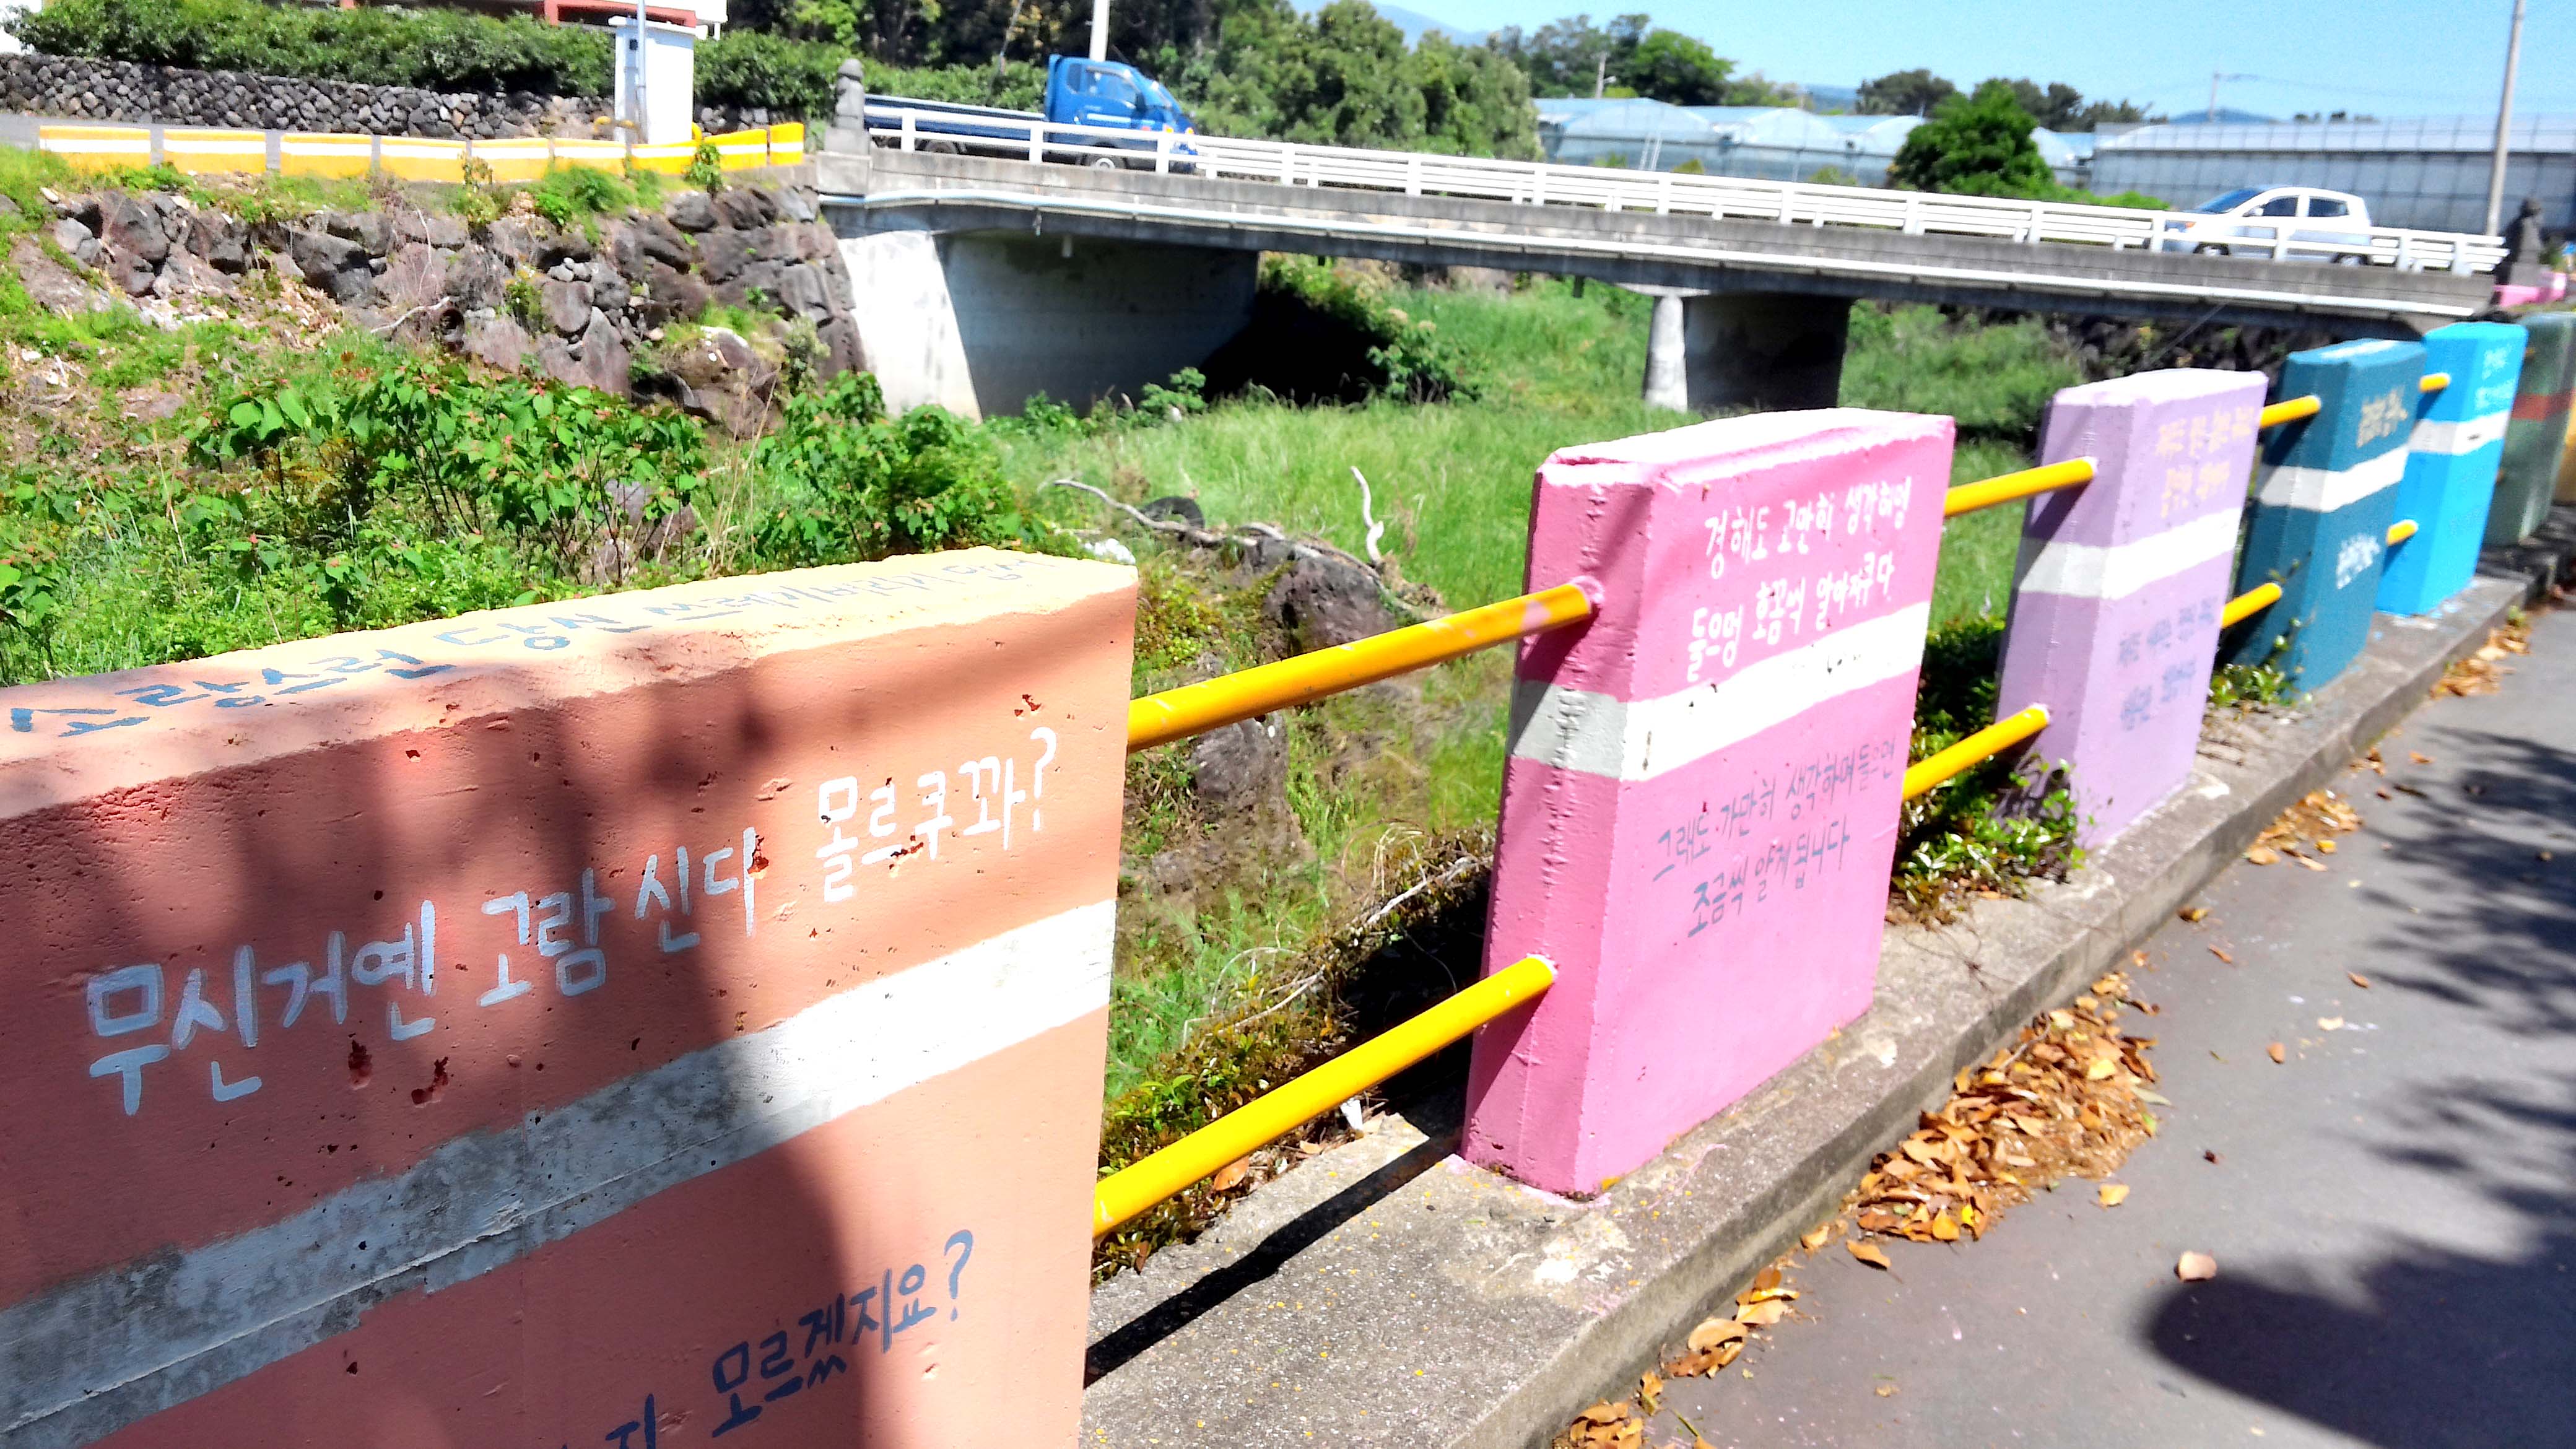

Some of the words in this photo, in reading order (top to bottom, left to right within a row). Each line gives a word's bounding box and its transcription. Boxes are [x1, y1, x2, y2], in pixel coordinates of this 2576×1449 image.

[1704, 508, 1771, 580] 경해도
[1686, 604, 1744, 683] 들으멍
[1652, 811, 1712, 882] 그래도
[1720, 775, 1776, 839] 가만히
[85, 899, 437, 1116] 무신거옌
[815, 726, 1058, 903] 몰르쿠꽈?
[1687, 856, 1749, 938] 조금씩
[711, 1228, 975, 1438] 모르겠지요?
